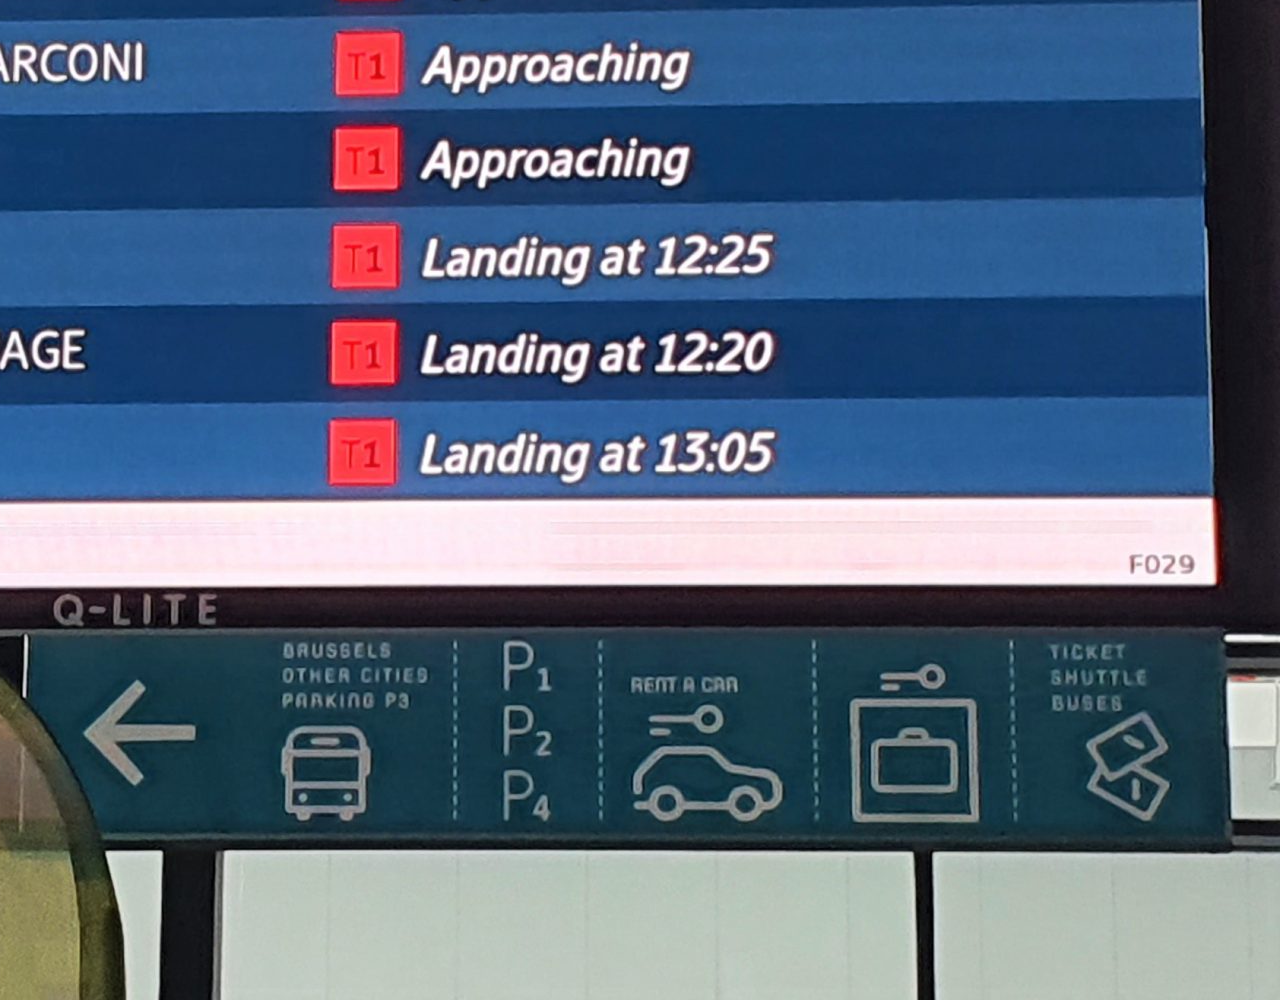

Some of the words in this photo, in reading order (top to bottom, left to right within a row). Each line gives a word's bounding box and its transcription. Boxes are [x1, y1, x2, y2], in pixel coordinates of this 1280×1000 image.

[347, 52, 387, 81] T1
[420, 42, 691, 94] Approaching
[345, 145, 385, 175] T1
[420, 137, 691, 189] Approaching
[343, 243, 383, 273] T1
[421, 236, 591, 286] Landing
[599, 238, 646, 276] at
[654, 233, 774, 276] 12:25
[342, 339, 382, 370] T1
[420, 333, 591, 384] Landing
[599, 335, 646, 373] at
[654, 331, 774, 373] 12:20
[341, 438, 381, 469] T1
[419, 432, 591, 484] Landing
[598, 435, 647, 473] at
[654, 430, 776, 473] 13:05
[1129, 554, 1196, 575] F029
[53, 594, 219, 627] Q-LITE
[283, 642, 392, 659] BRUSSELS
[503, 640, 552, 692] P1
[1049, 643, 1127, 660] TICKET
[282, 667, 351, 684] OTHER
[361, 667, 428, 684] CITIES
[631, 676, 677, 693] RENT
[683, 676, 695, 693] A
[701, 676, 739, 693] CAR
[1051, 668, 1147, 686] SHUTTLE
[282, 692, 375, 709] PARKING
[385, 692, 410, 709] P3
[1051, 694, 1123, 712] BUSES
[503, 705, 552, 756] P2
[503, 769, 551, 821] P4
